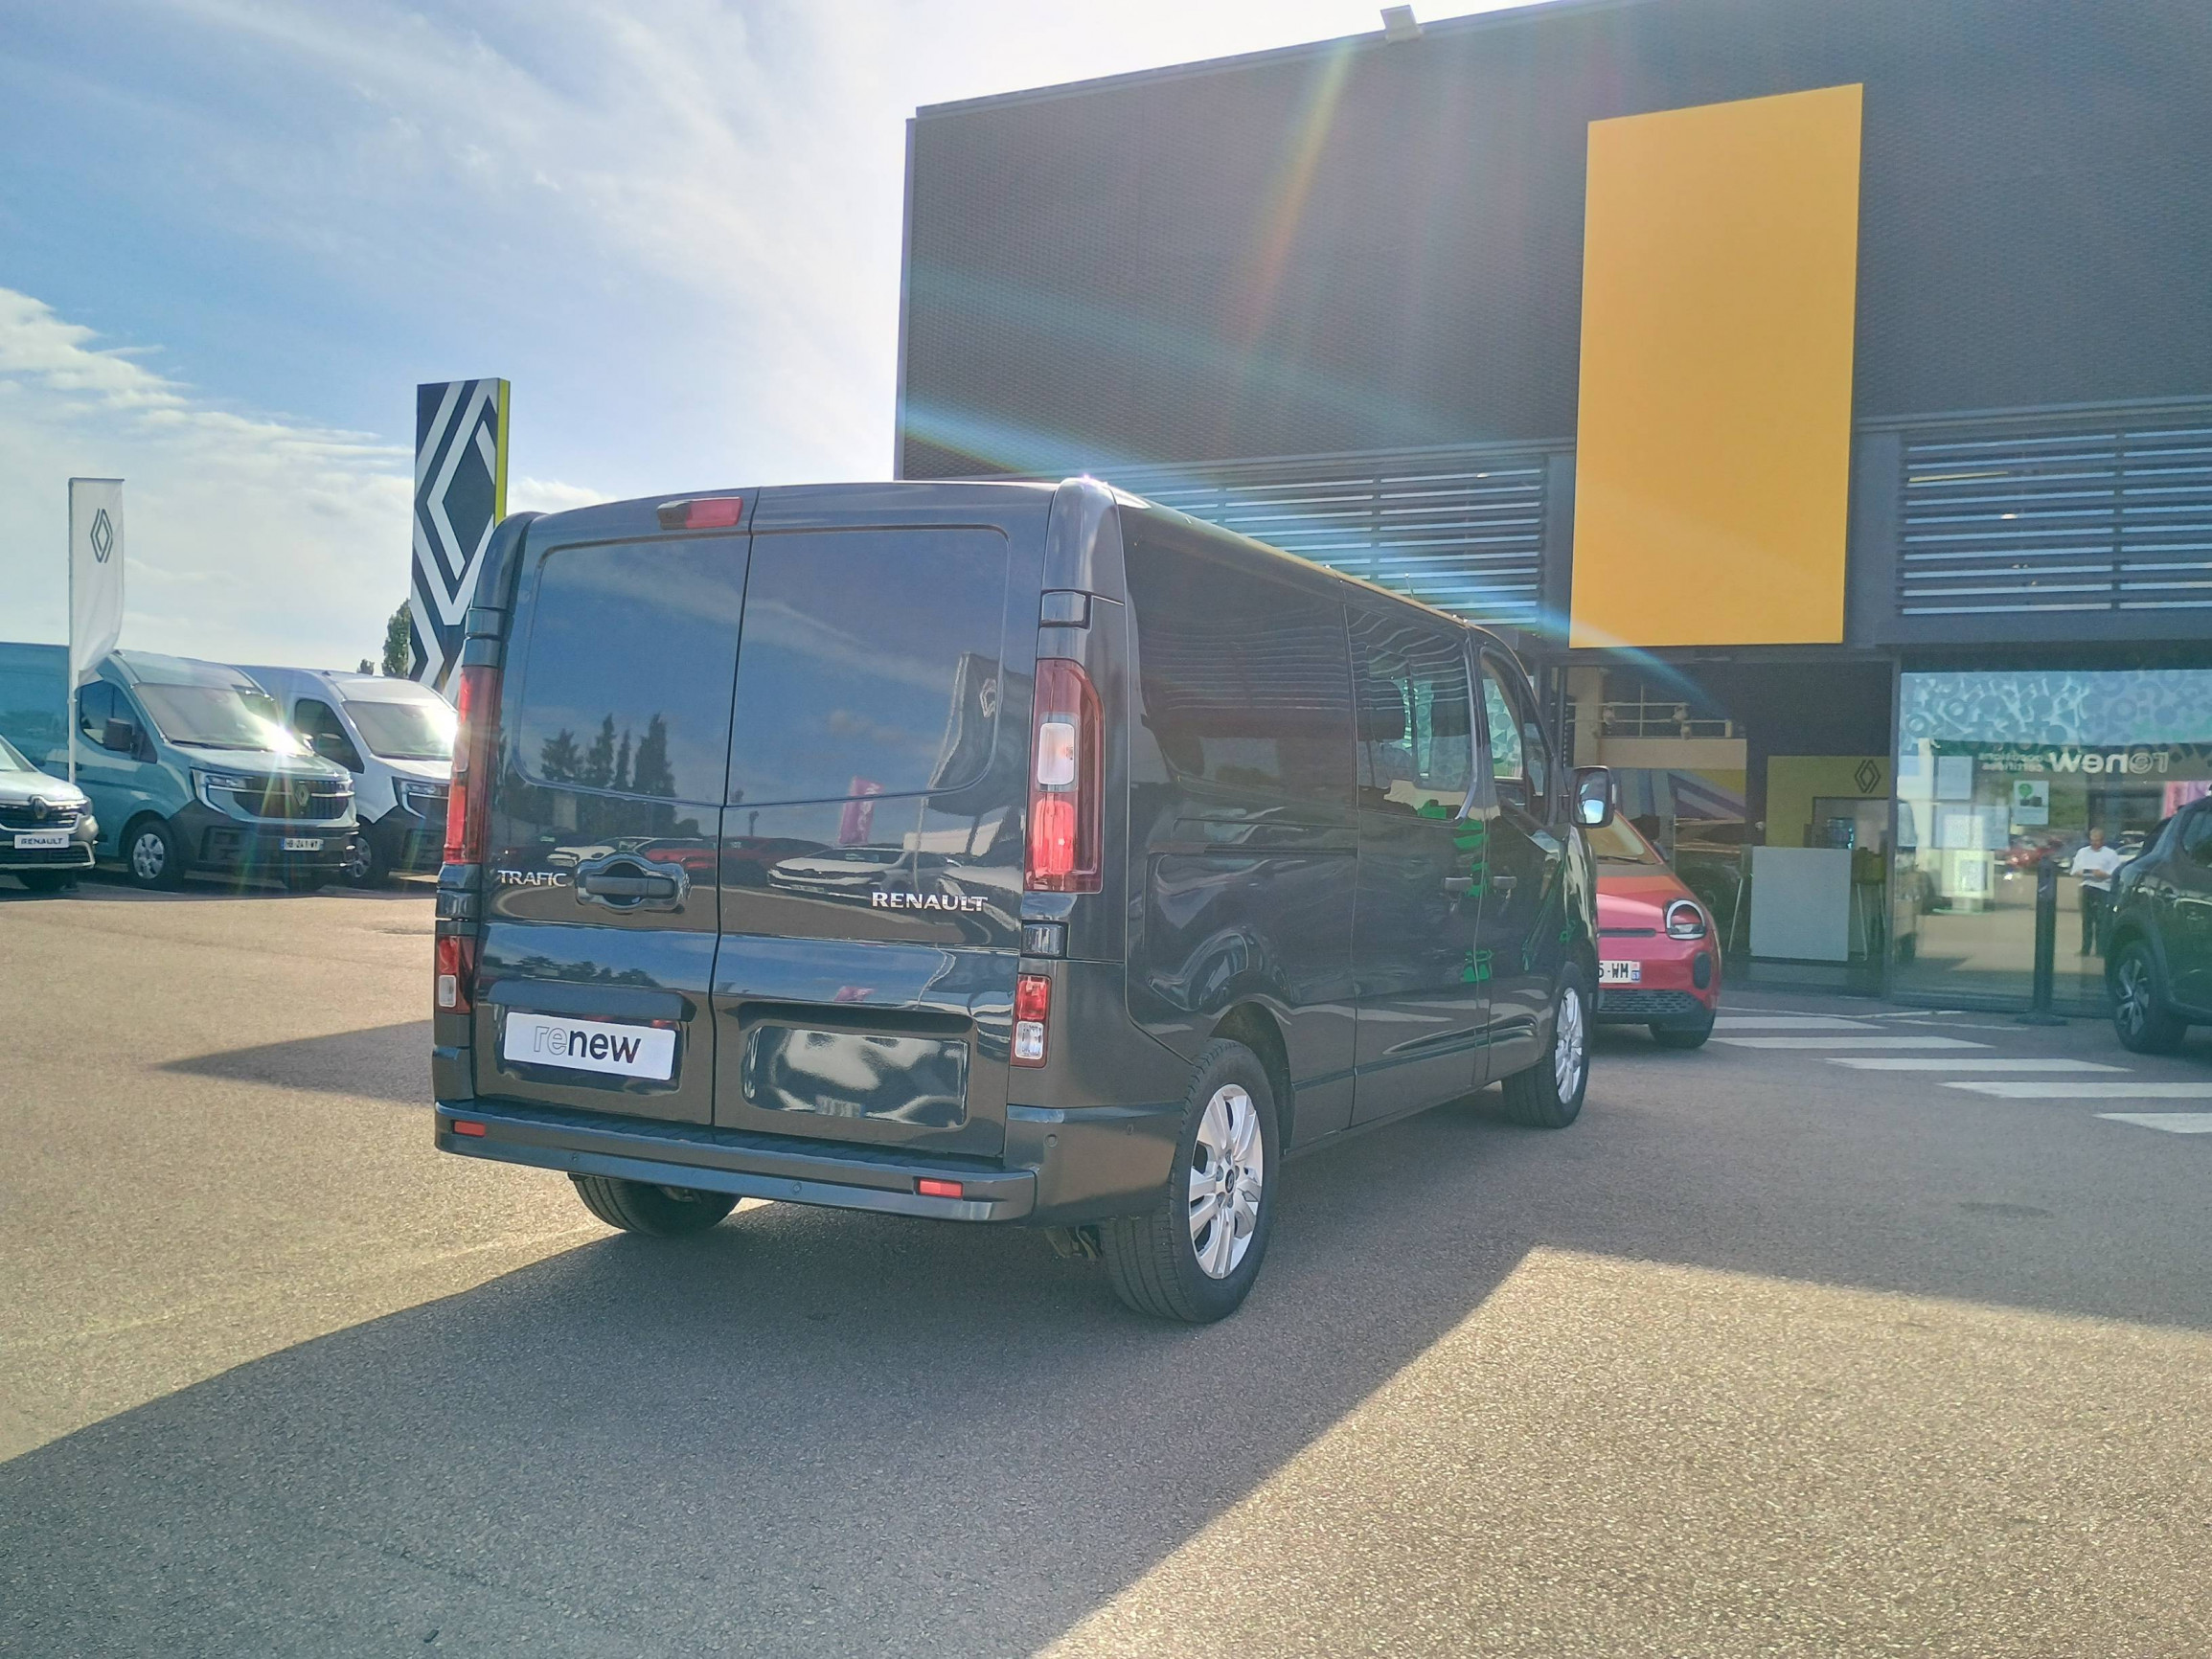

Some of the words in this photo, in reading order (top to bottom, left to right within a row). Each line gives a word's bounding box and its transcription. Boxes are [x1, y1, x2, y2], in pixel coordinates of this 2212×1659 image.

[497, 870, 567, 887] TRAFIC
[872, 892, 989, 912] RENAULT
[534, 1025, 642, 1064] renew
